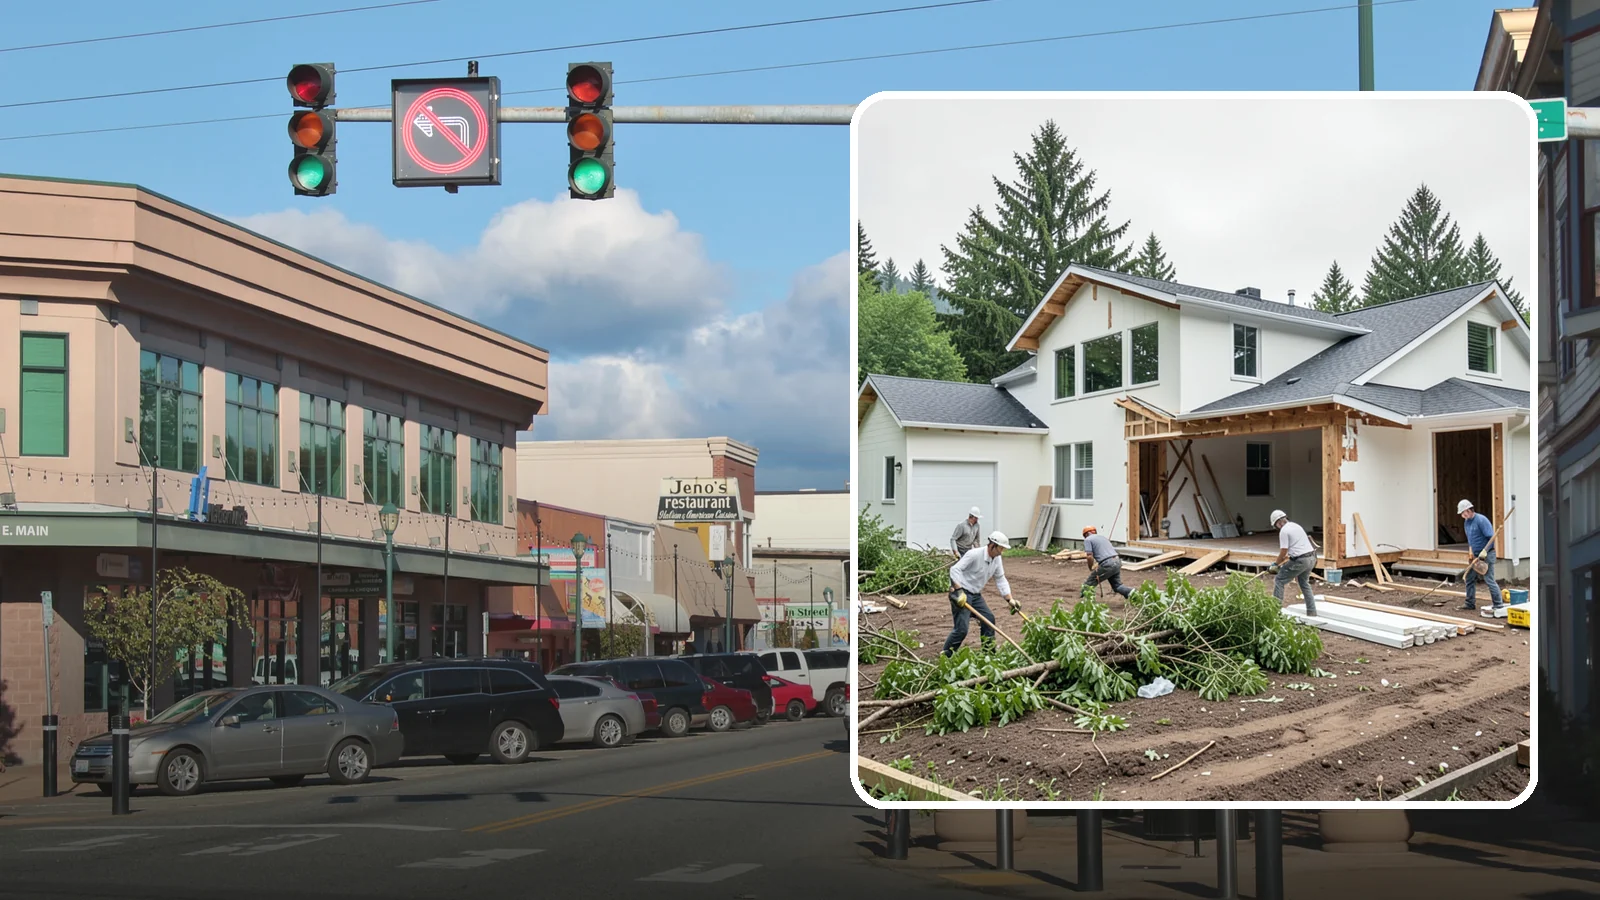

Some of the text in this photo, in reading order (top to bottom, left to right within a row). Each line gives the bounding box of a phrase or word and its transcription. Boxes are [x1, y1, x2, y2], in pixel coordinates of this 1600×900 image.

[669, 480, 727, 494] Jeno's
[665, 496, 731, 509] restaurant
[658, 510, 682, 520] Italian
[686, 510, 714, 519] American
[714, 510, 737, 519] Cuisine
[2, 525, 49, 536] E. MAIN
[797, 607, 829, 617] Street
